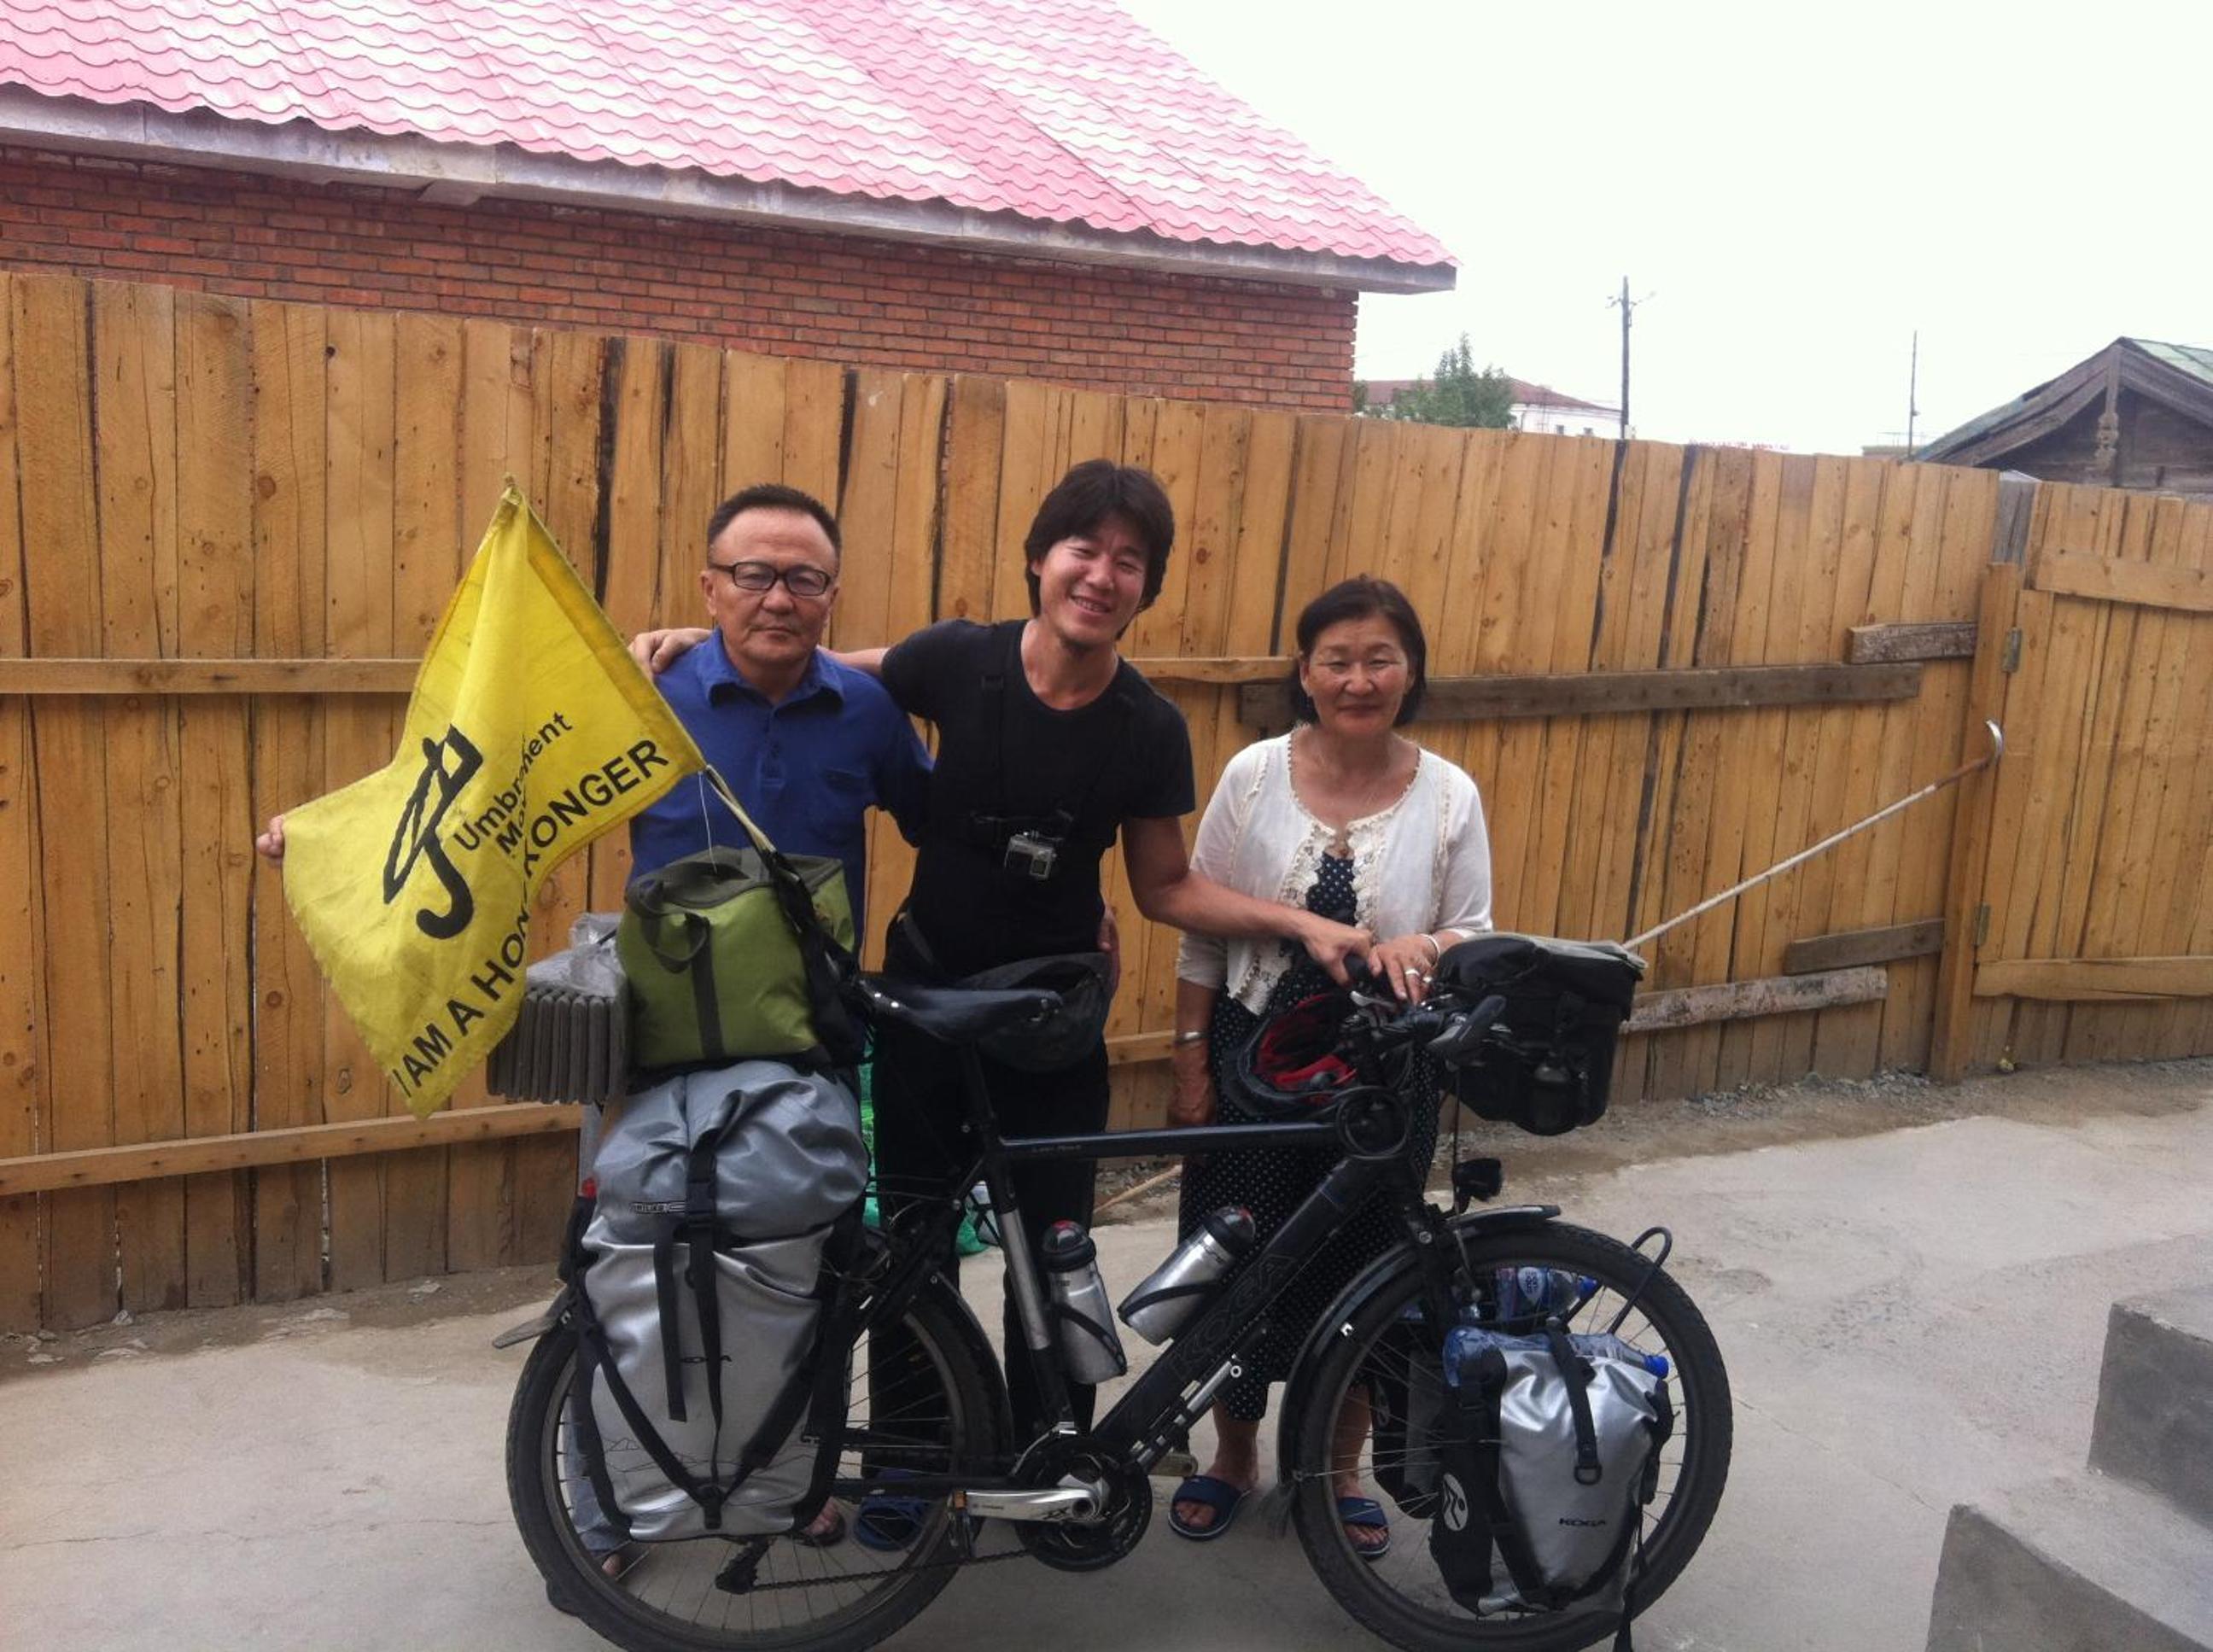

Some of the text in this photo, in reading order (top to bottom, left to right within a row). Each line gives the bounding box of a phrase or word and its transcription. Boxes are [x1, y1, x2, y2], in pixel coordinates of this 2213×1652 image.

[393, 739, 669, 1098] I AM A HONKONGER
[1558, 1517, 1606, 1527] KOGA
